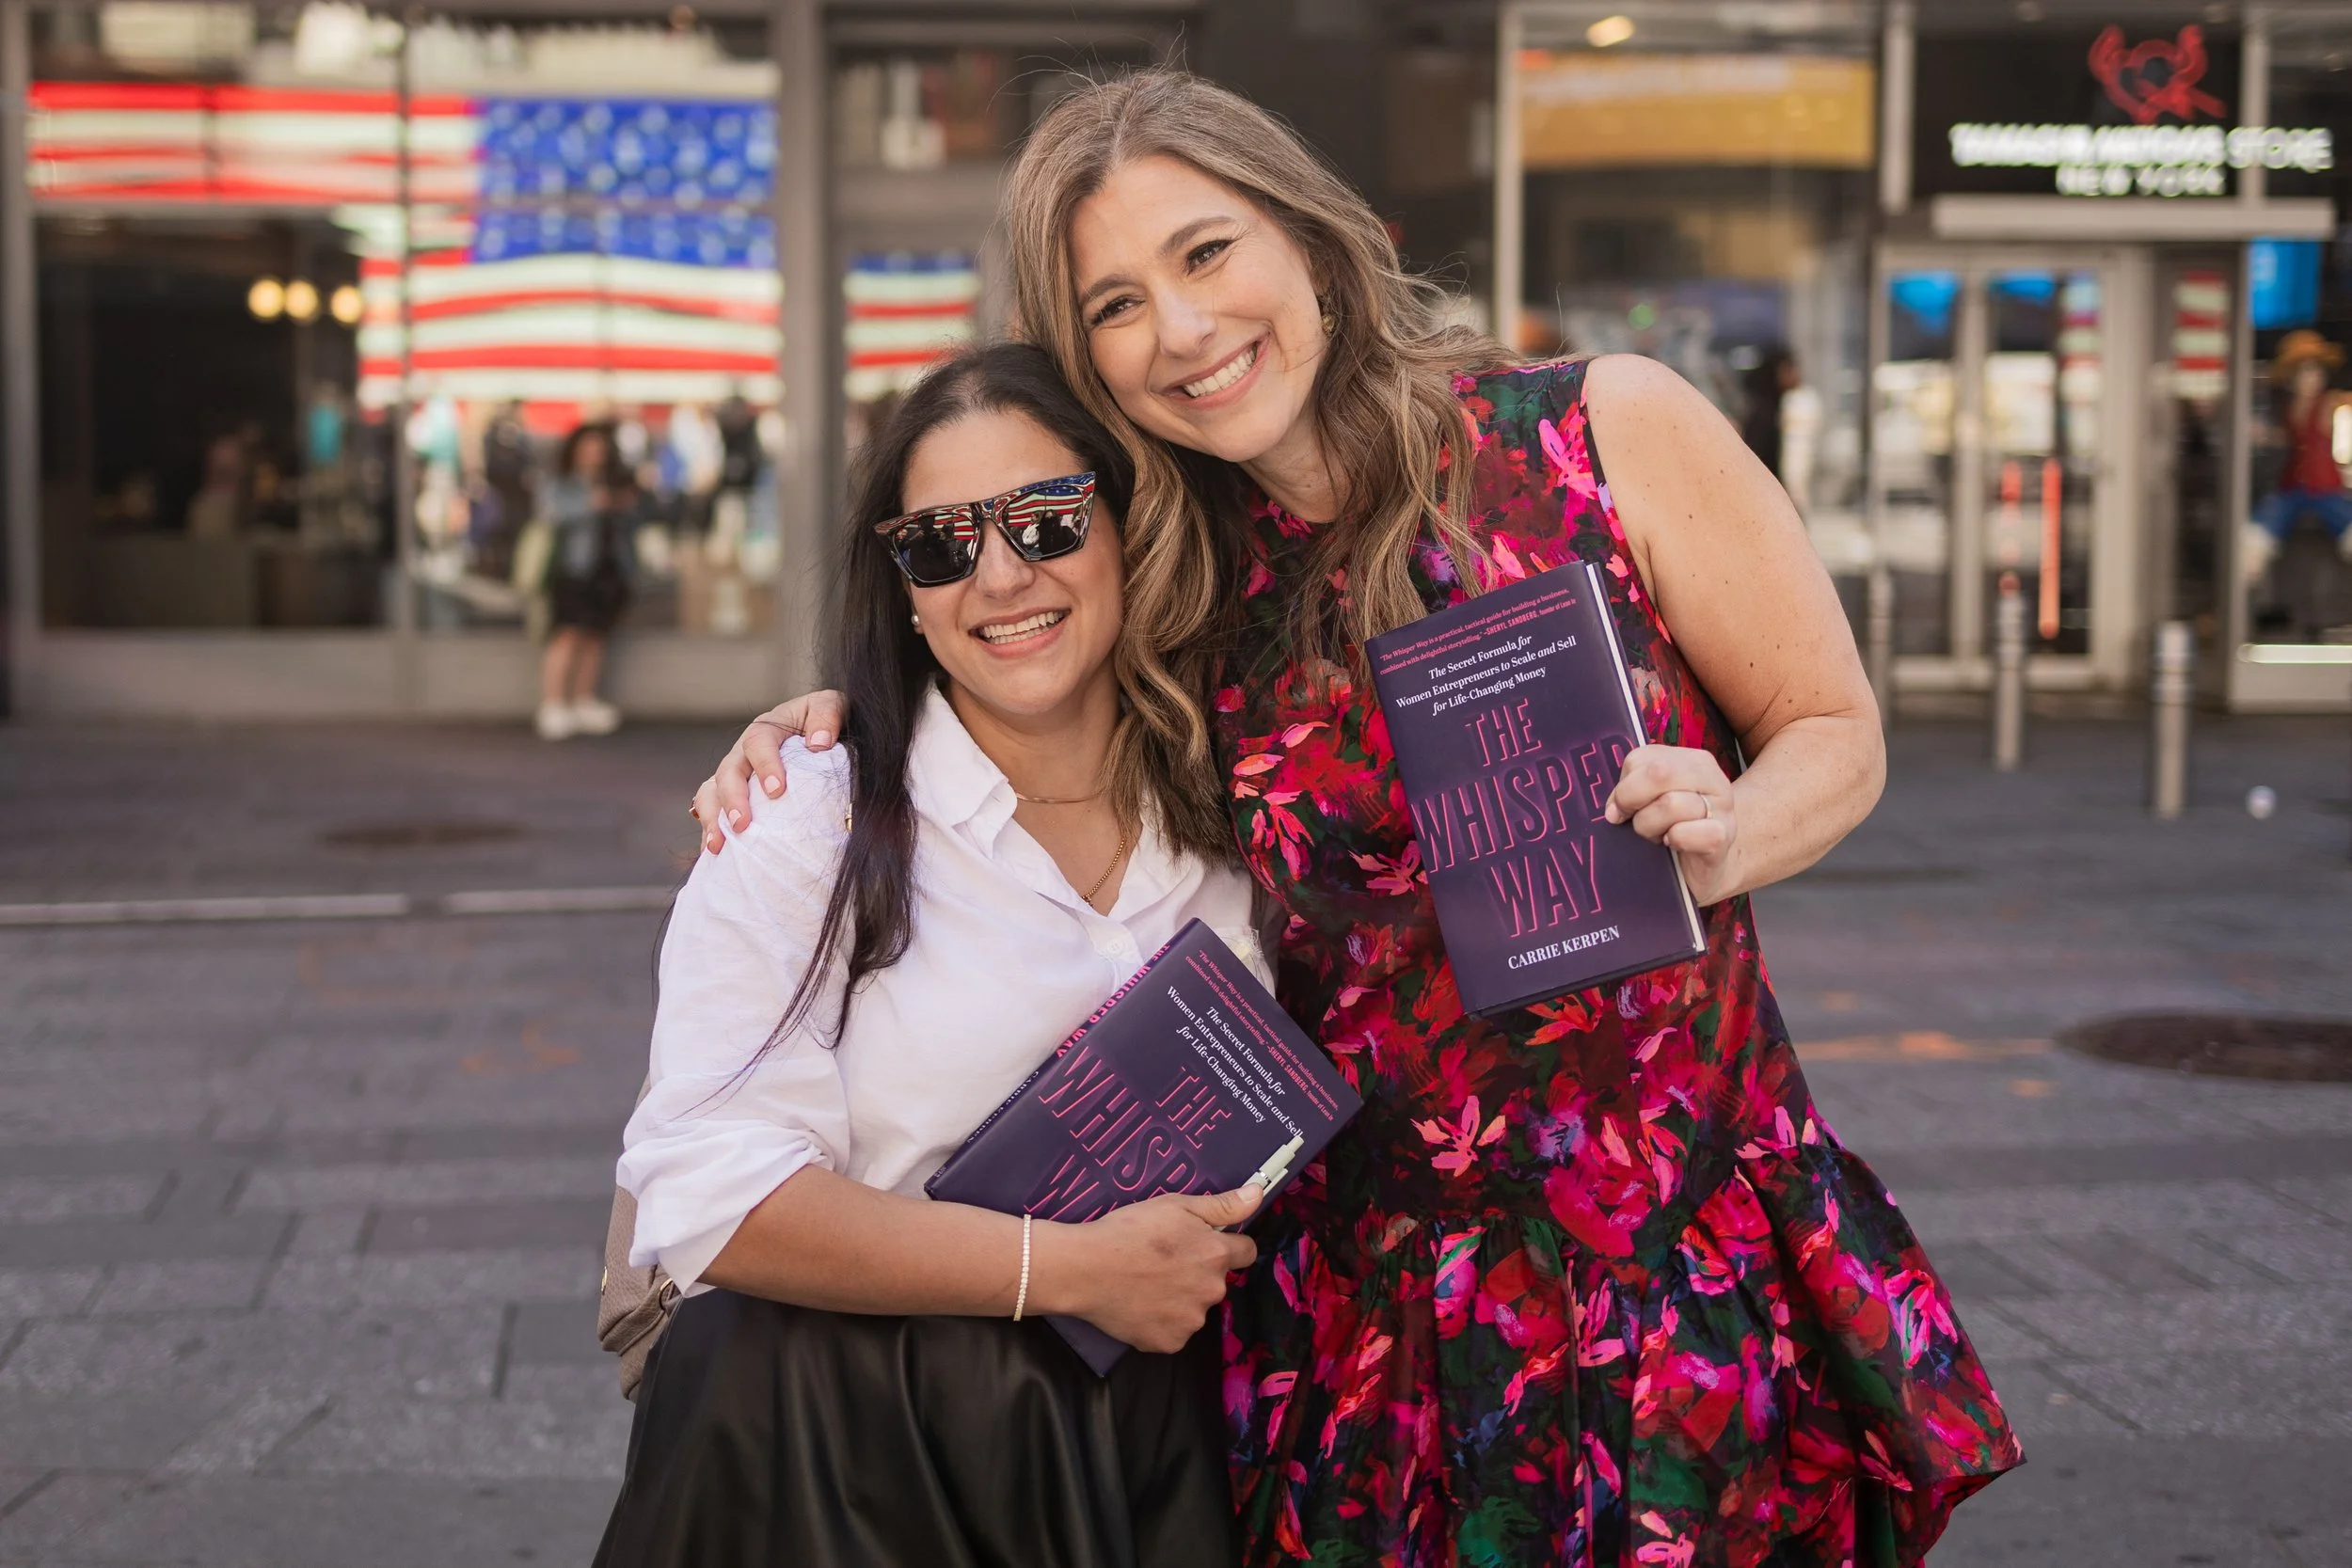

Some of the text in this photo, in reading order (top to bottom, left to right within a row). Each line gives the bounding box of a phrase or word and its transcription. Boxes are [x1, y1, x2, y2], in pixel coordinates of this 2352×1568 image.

[2226, 127, 2333, 173] STORE
[1380, 659, 1406, 674] combined
[1406, 656, 1421, 664] with
[1419, 644, 1447, 659] delightful
[1391, 644, 1415, 657] Whisper
[1464, 617, 1486, 630] tactical
[1486, 612, 1502, 623] guide
[1511, 599, 1536, 612] building
[1428, 636, 1532, 679] The Secret Formula for
[1395, 635, 1576, 707] Women Entrepreneurs to Scale and Sell
[1432, 666, 1545, 716] for Life-Changing Money
[1461, 695, 1542, 767] THE
[1482, 833, 1603, 938] WAY
[1508, 925, 1619, 969] CARRIE KERPEN
[1184, 956, 1210, 981] combined
[1208, 979, 1219, 992] with
[1217, 991, 1241, 1016] delightful
[1206, 1006, 1285, 1095] The Secret Formula for
[1208, 961, 1228, 982] Whisper
[1226, 981, 1237, 994] Way
[1263, 1023, 1281, 1045] tactical
[1278, 1041, 1292, 1057] guide
[1290, 1054, 1301, 1066] for
[1297, 1062, 1316, 1085] building
[1167, 986, 1304, 1137] Women Entrepreneurs to Scale and Sell
[1175, 1025, 1265, 1122] for Life-Changing Money
[1037, 1041, 1216, 1201] WHISP
[1153, 1060, 1233, 1150] THE
